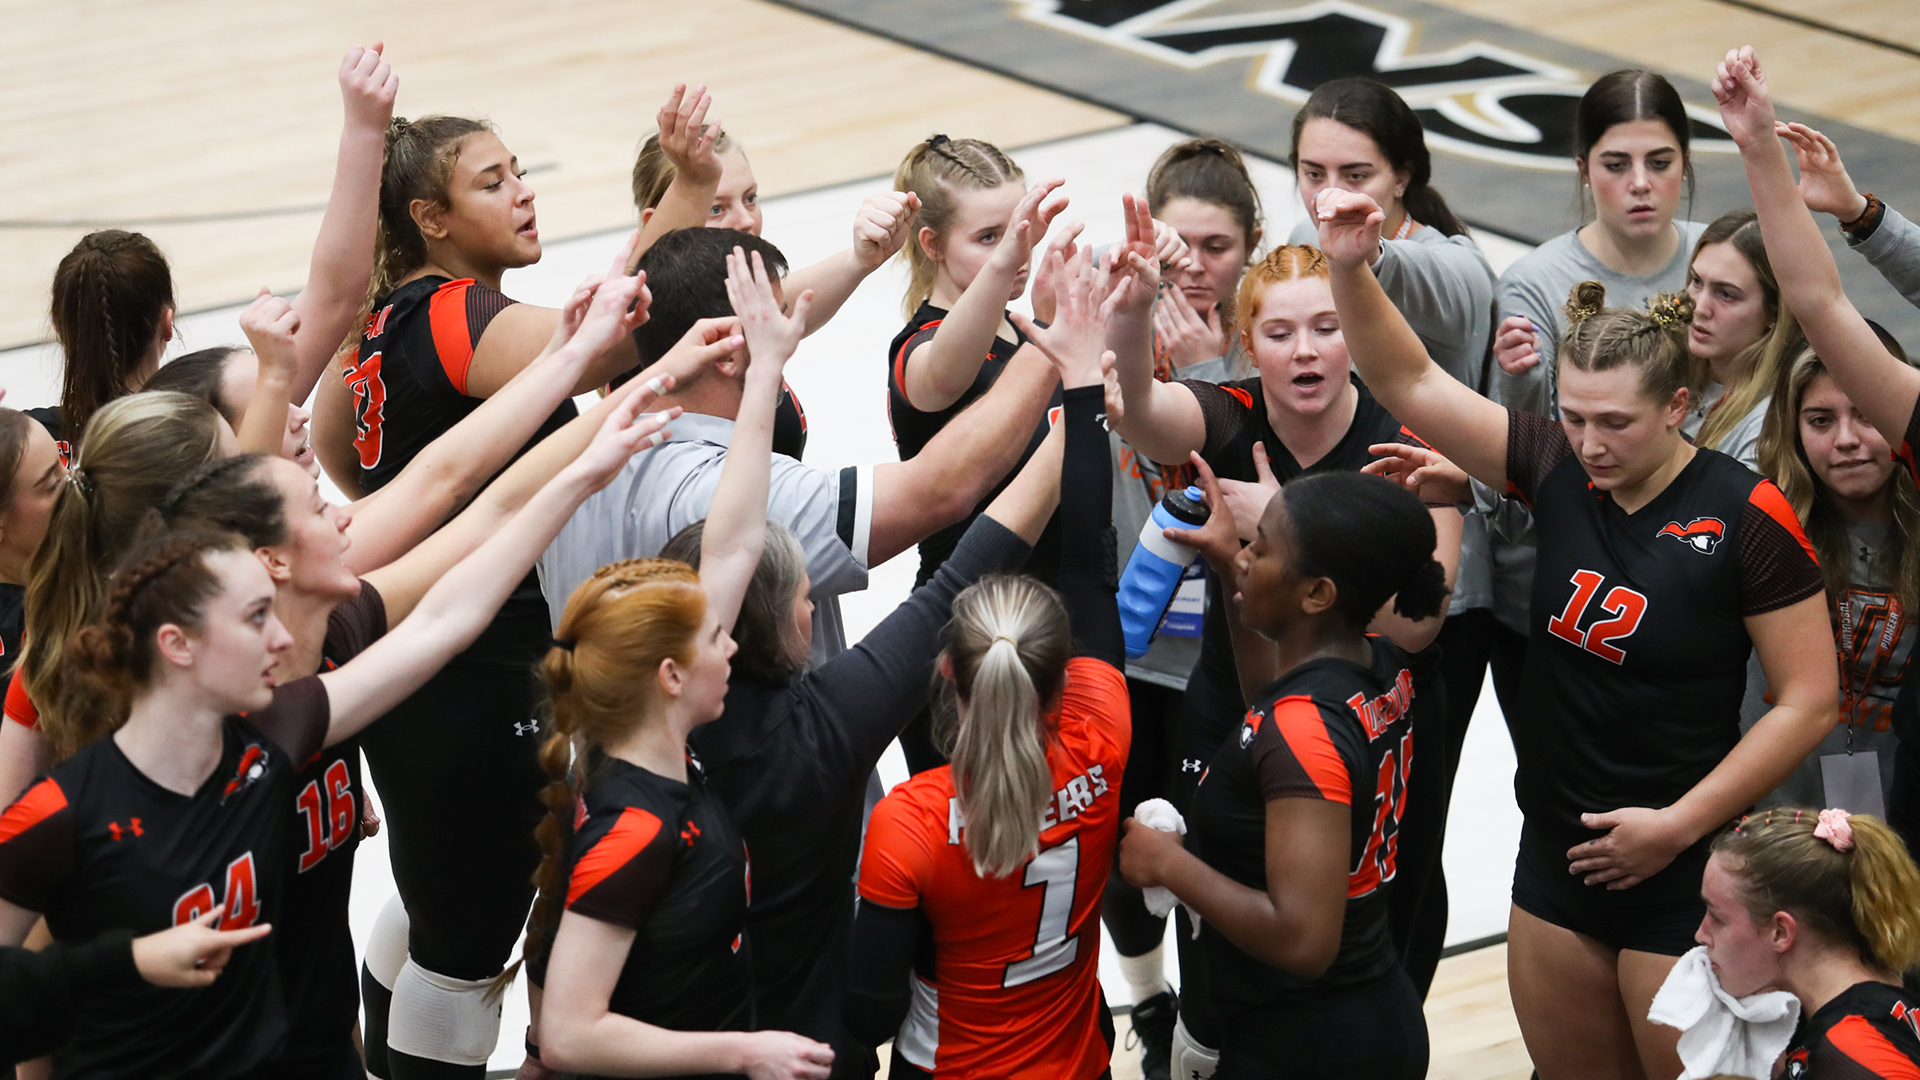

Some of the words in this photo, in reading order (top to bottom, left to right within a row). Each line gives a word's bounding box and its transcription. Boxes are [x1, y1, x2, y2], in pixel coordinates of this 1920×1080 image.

[1547, 568, 1649, 666] 12
[1839, 601, 1853, 650] TUSCULUM
[1880, 611, 1900, 650] PIONEER
[296, 758, 356, 875] 16
[1001, 833, 1081, 991] 1
